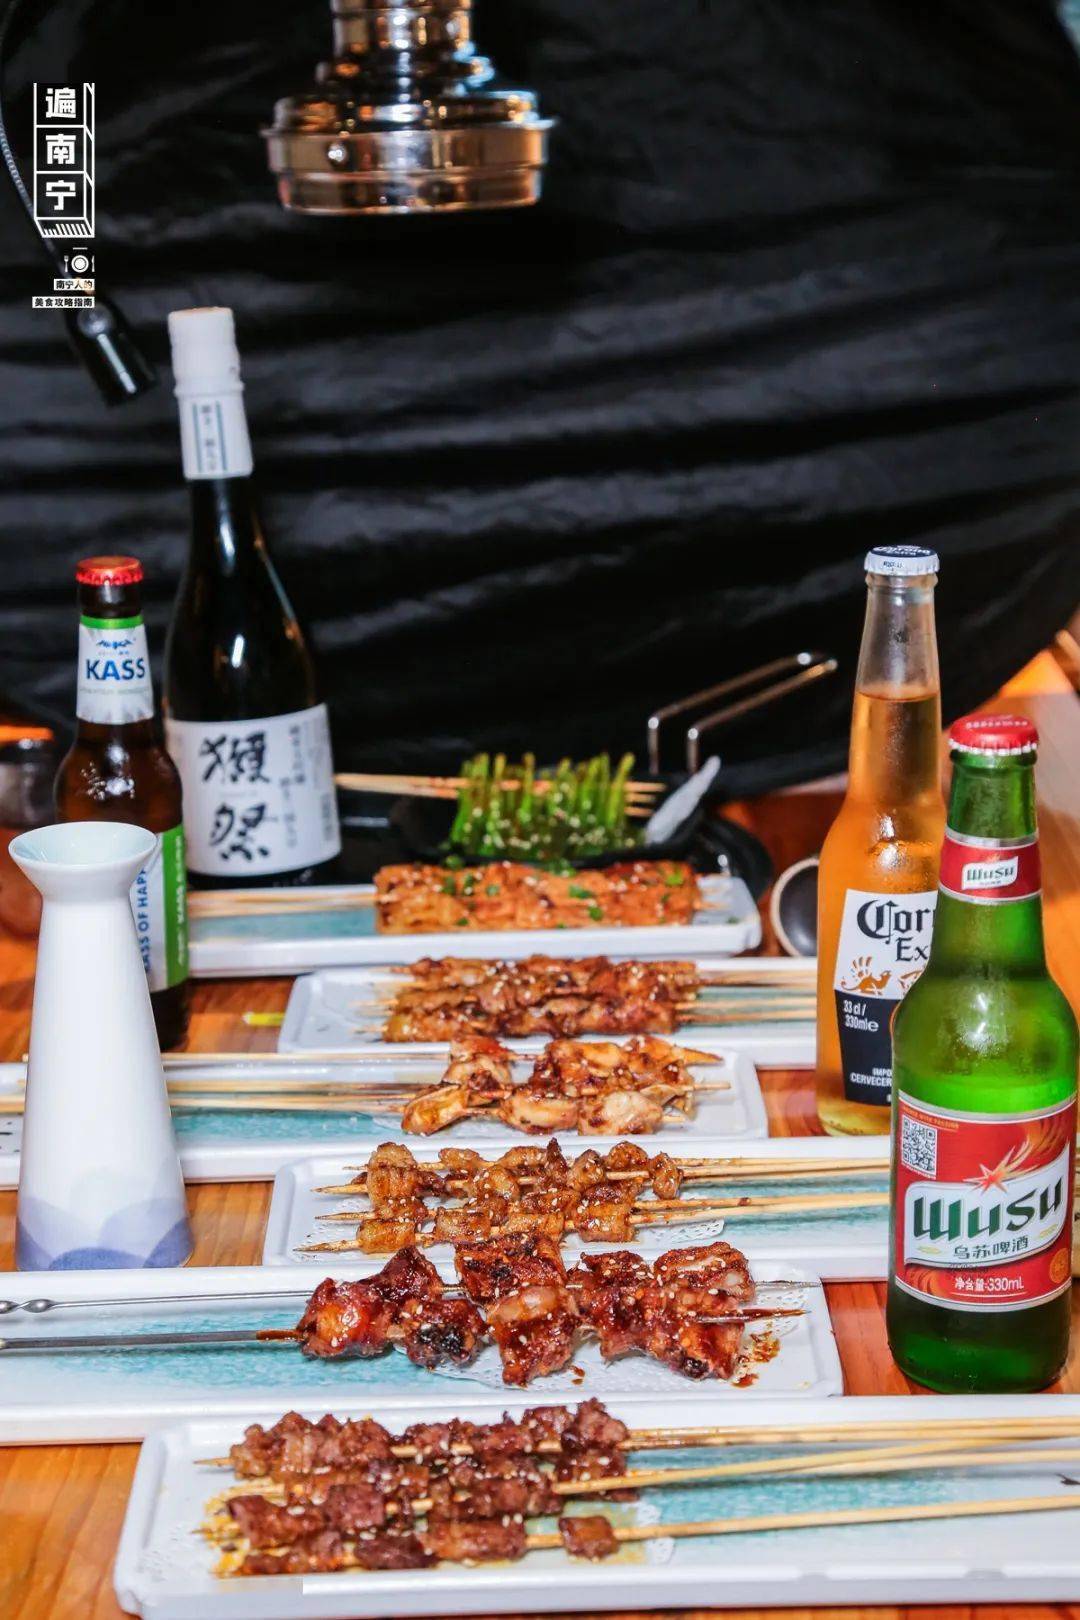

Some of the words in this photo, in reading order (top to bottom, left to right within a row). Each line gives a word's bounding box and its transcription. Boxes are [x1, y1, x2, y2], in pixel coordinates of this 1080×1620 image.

[86, 657, 146, 681] KASS
[138, 912, 149, 931] OF
[857, 900, 936, 944] Cor
[843, 999, 853, 1013] 33
[953, 1234, 1029, 1260] 乌苏啤酒
